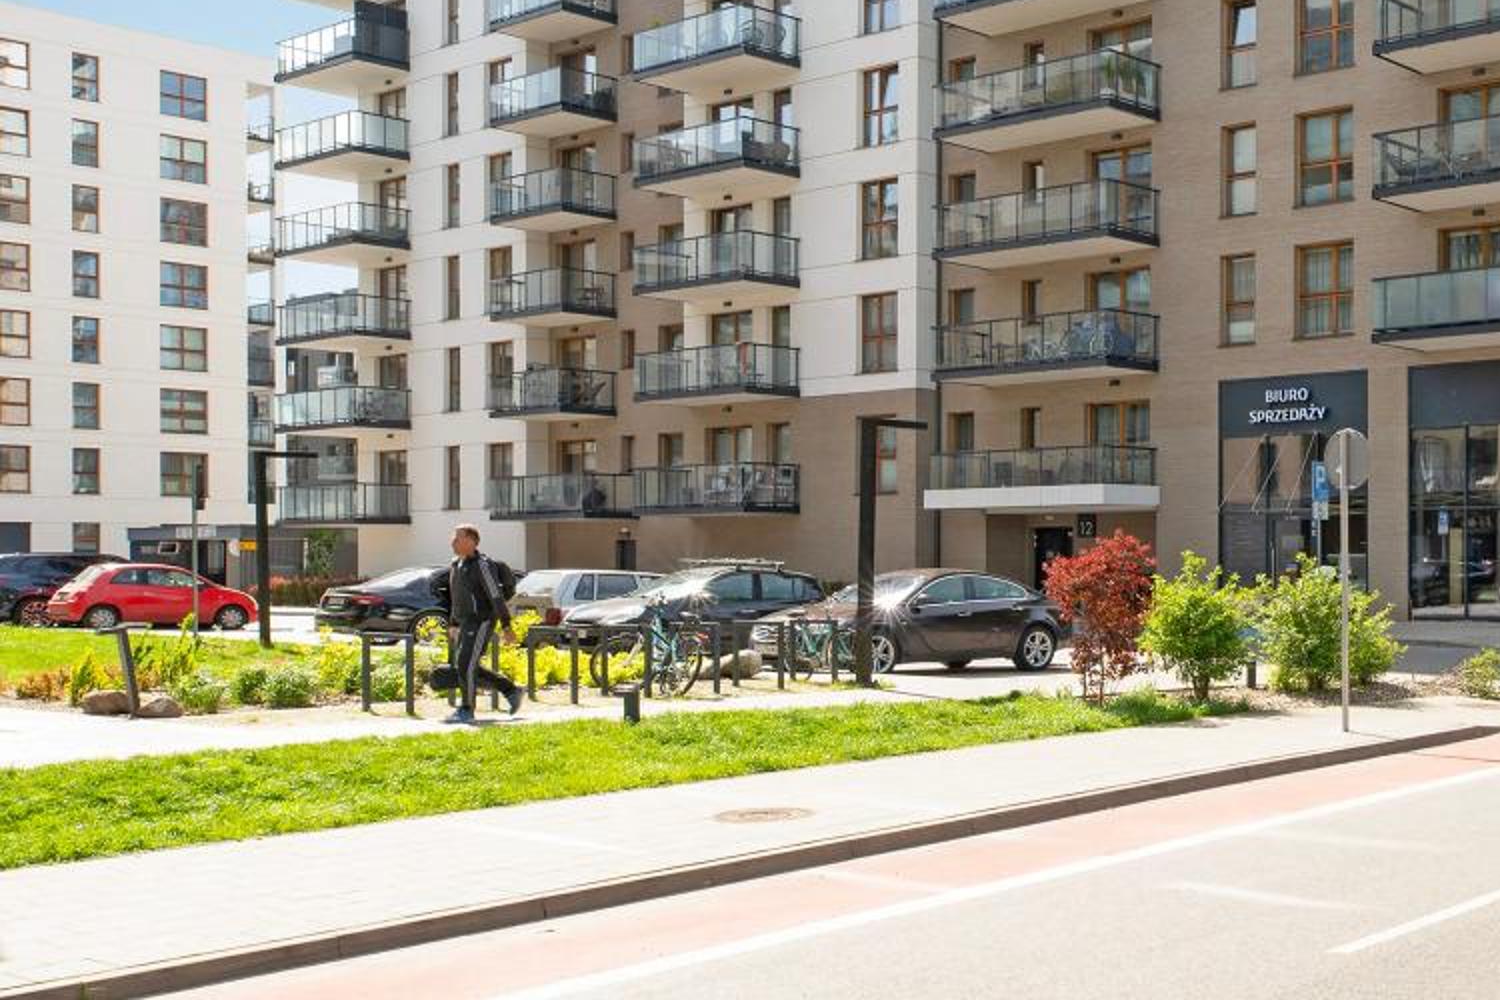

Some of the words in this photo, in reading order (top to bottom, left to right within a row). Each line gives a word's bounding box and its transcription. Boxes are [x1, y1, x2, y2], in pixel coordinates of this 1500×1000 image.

[1265, 387, 1309, 403] BIURO
[1248, 403, 1326, 424] SPRZEDAŻY
[1315, 466, 1326, 489] P
[1080, 521, 1093, 535] 12
